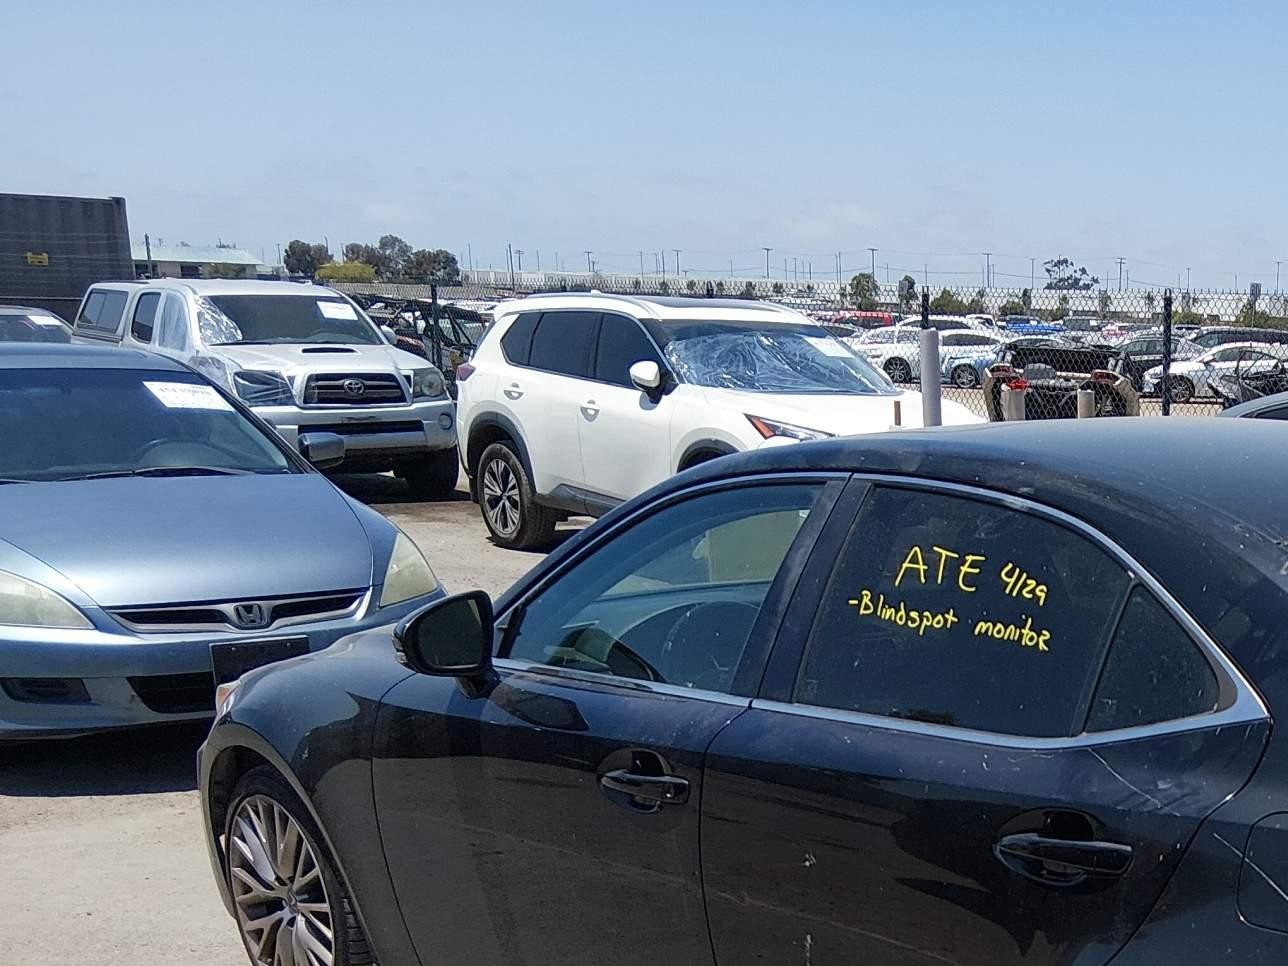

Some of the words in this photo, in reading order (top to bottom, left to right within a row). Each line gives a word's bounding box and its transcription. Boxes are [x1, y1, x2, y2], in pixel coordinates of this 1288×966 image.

[894, 545, 987, 592] ATE
[1000, 562, 1049, 607] 4/29
[847, 589, 960, 637] -Blindspot
